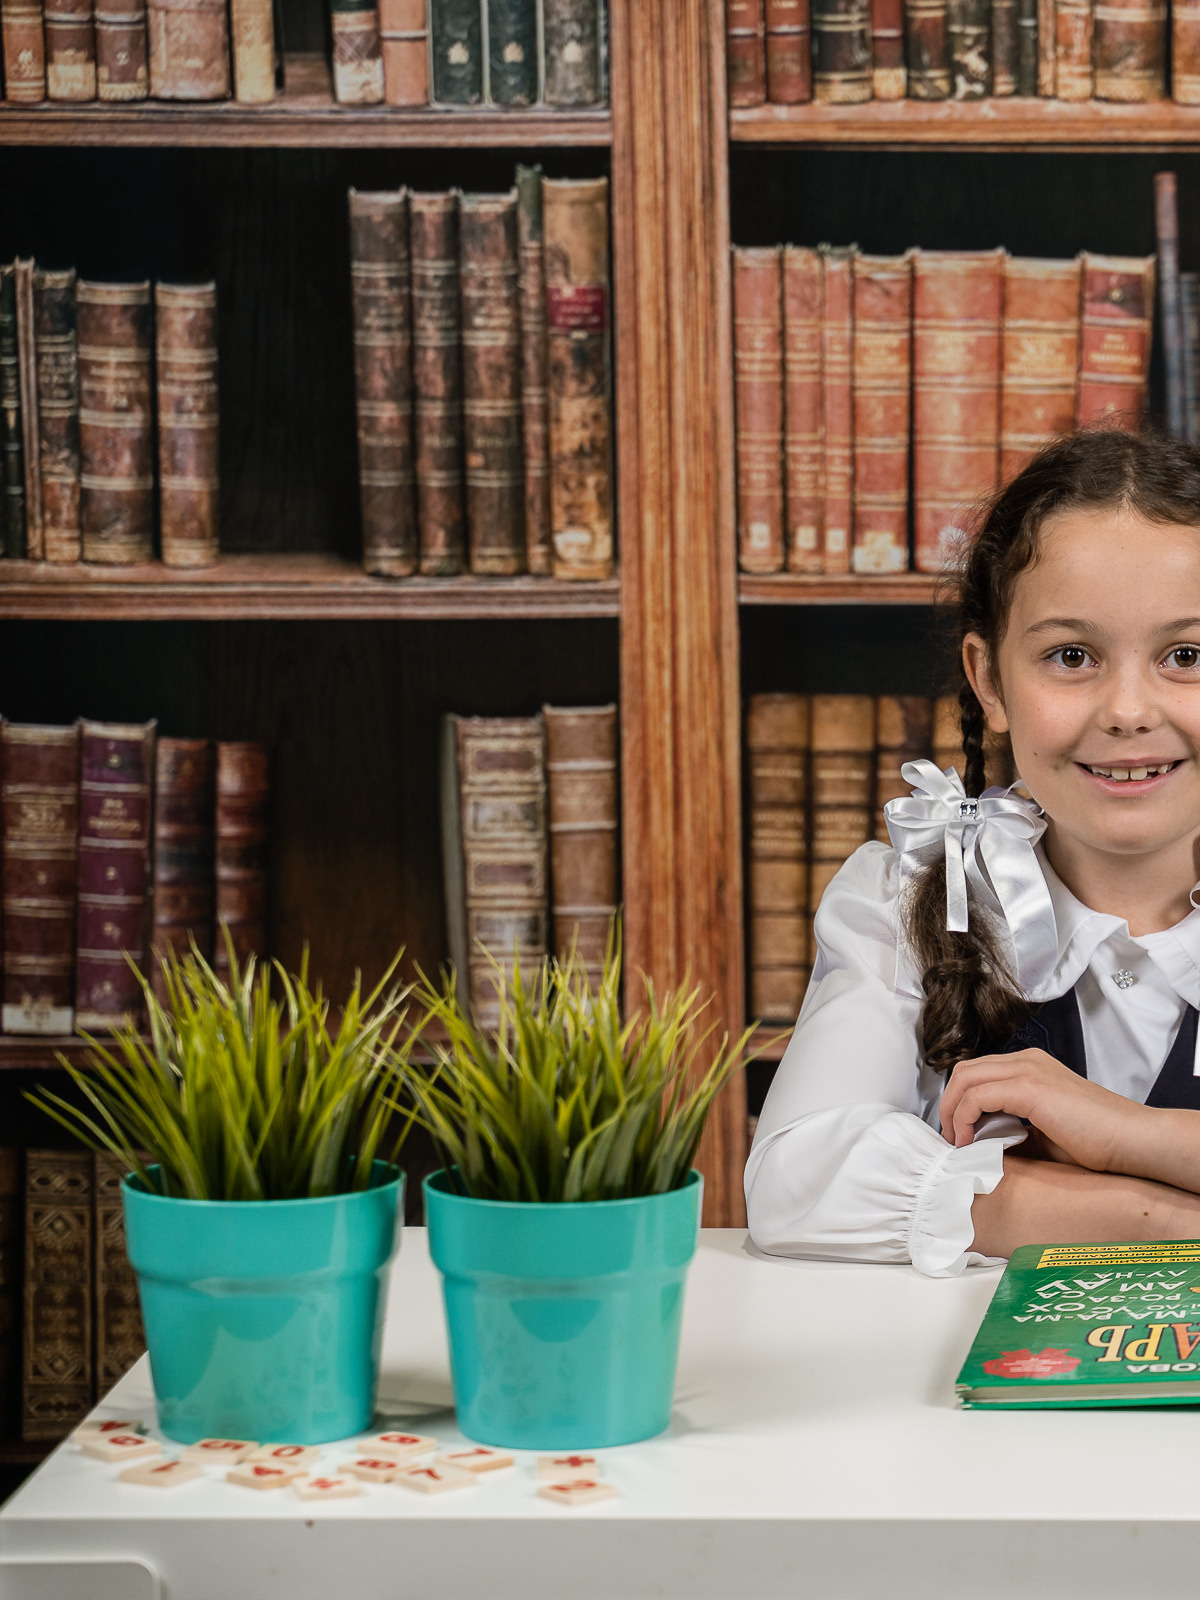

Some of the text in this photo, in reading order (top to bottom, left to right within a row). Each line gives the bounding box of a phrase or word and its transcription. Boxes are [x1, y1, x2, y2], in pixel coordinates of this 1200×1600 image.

[1093, 1269, 1189, 1279] ЛУ-НА
[1035, 1278, 1187, 1293] АМ АУ
[1036, 1290, 1182, 1303] РО-ЗА СА
[1024, 1302, 1087, 1313] ОХ
[1095, 1304, 1133, 1315] УС
[1012, 1311, 1113, 1322] РА-МА
